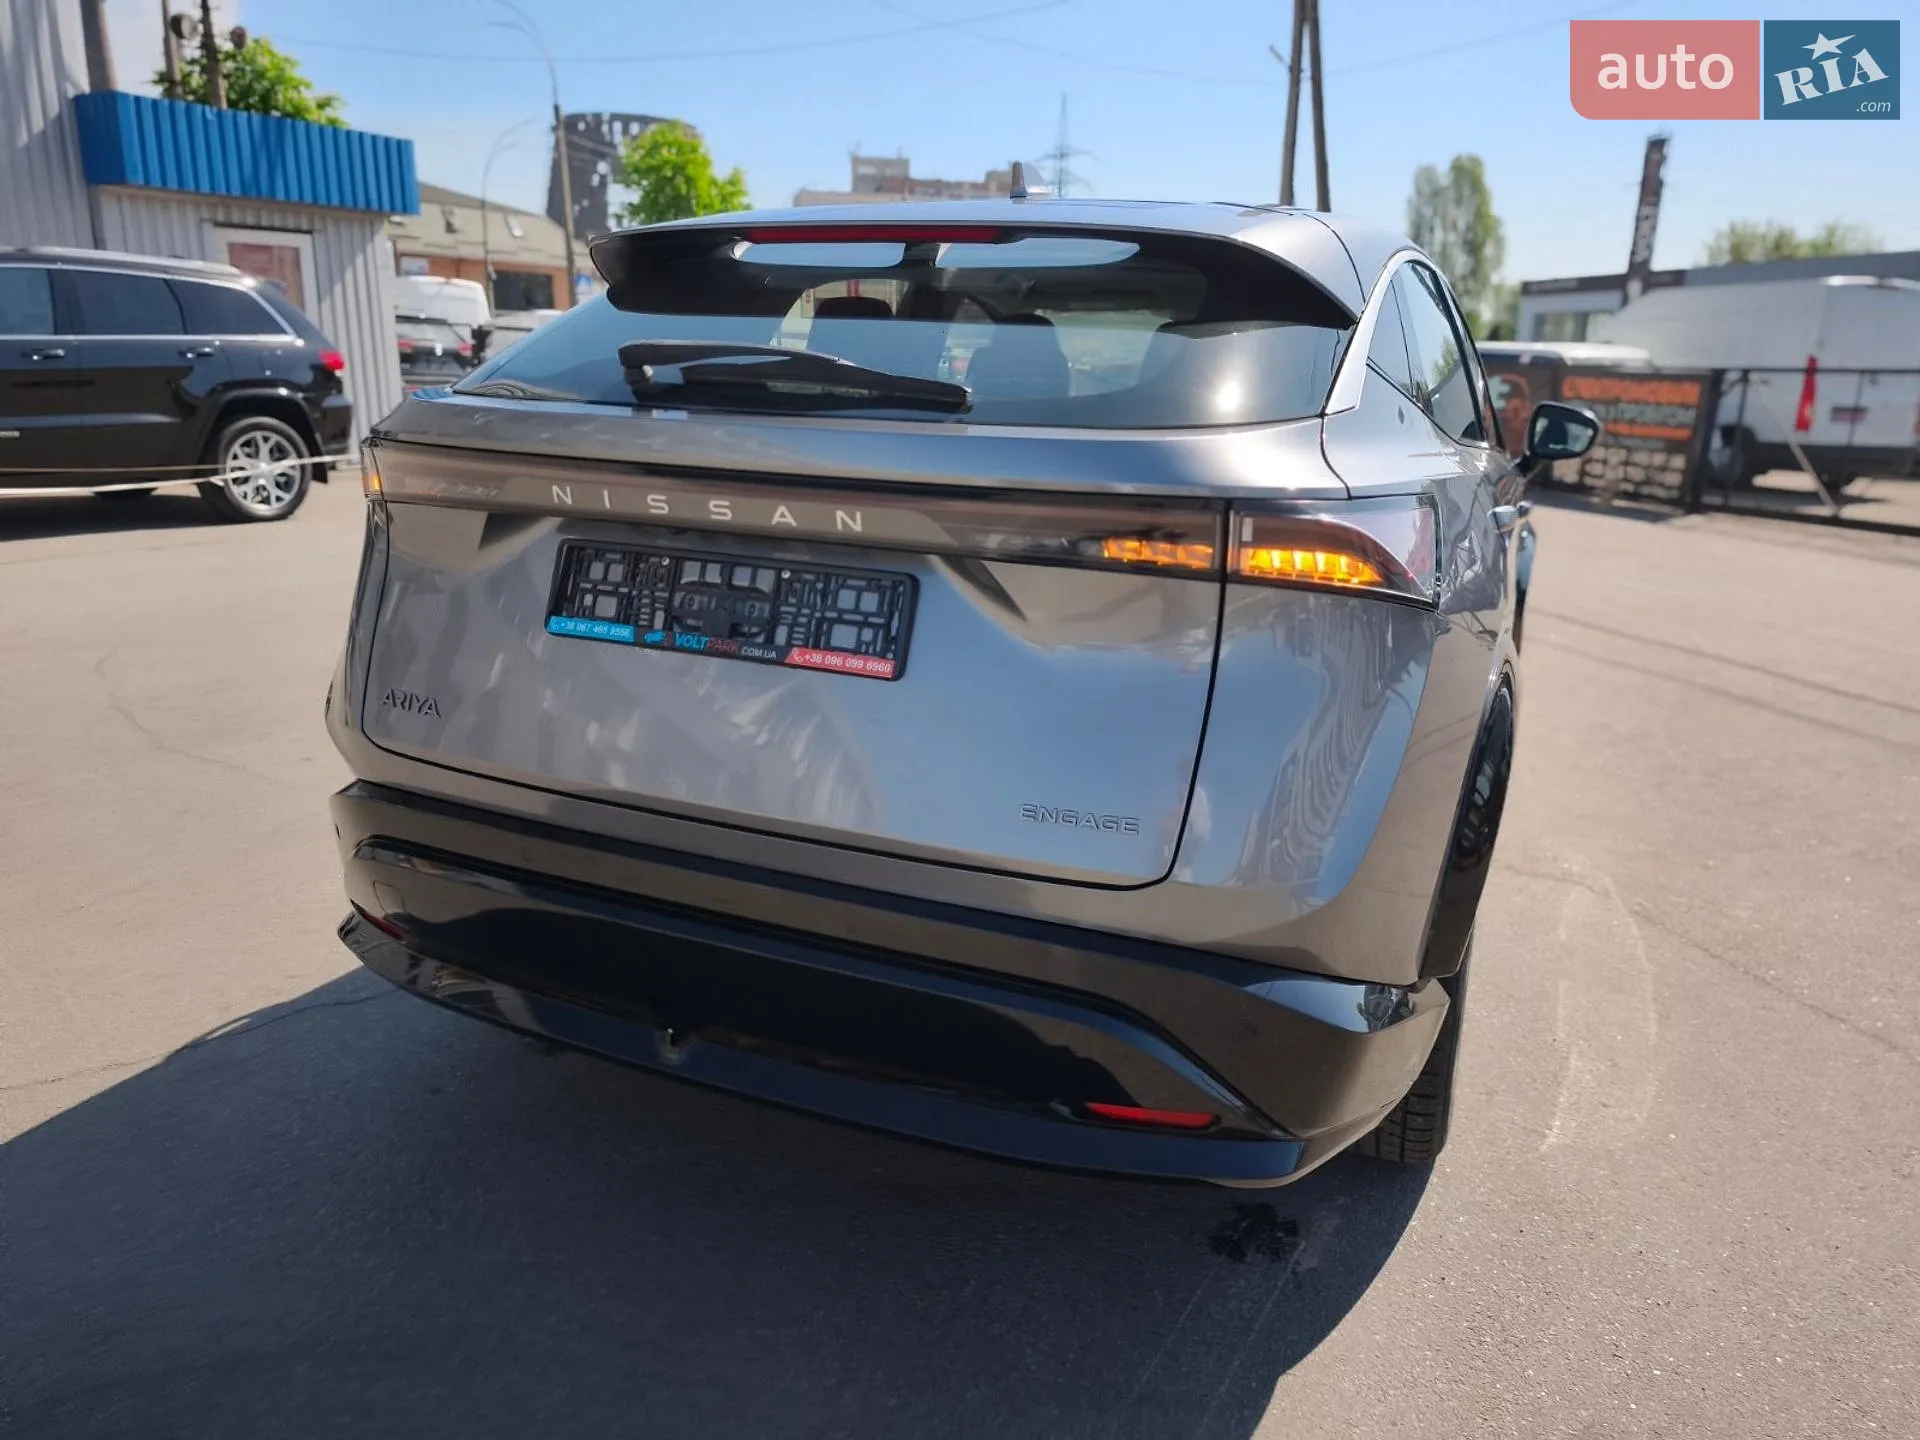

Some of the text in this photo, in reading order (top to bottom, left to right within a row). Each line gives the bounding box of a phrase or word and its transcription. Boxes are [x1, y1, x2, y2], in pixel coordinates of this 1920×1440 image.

[551, 485, 863, 532] NISSAN
[382, 687, 441, 719] ARIYA
[1020, 801, 1141, 835] ENGAGE
